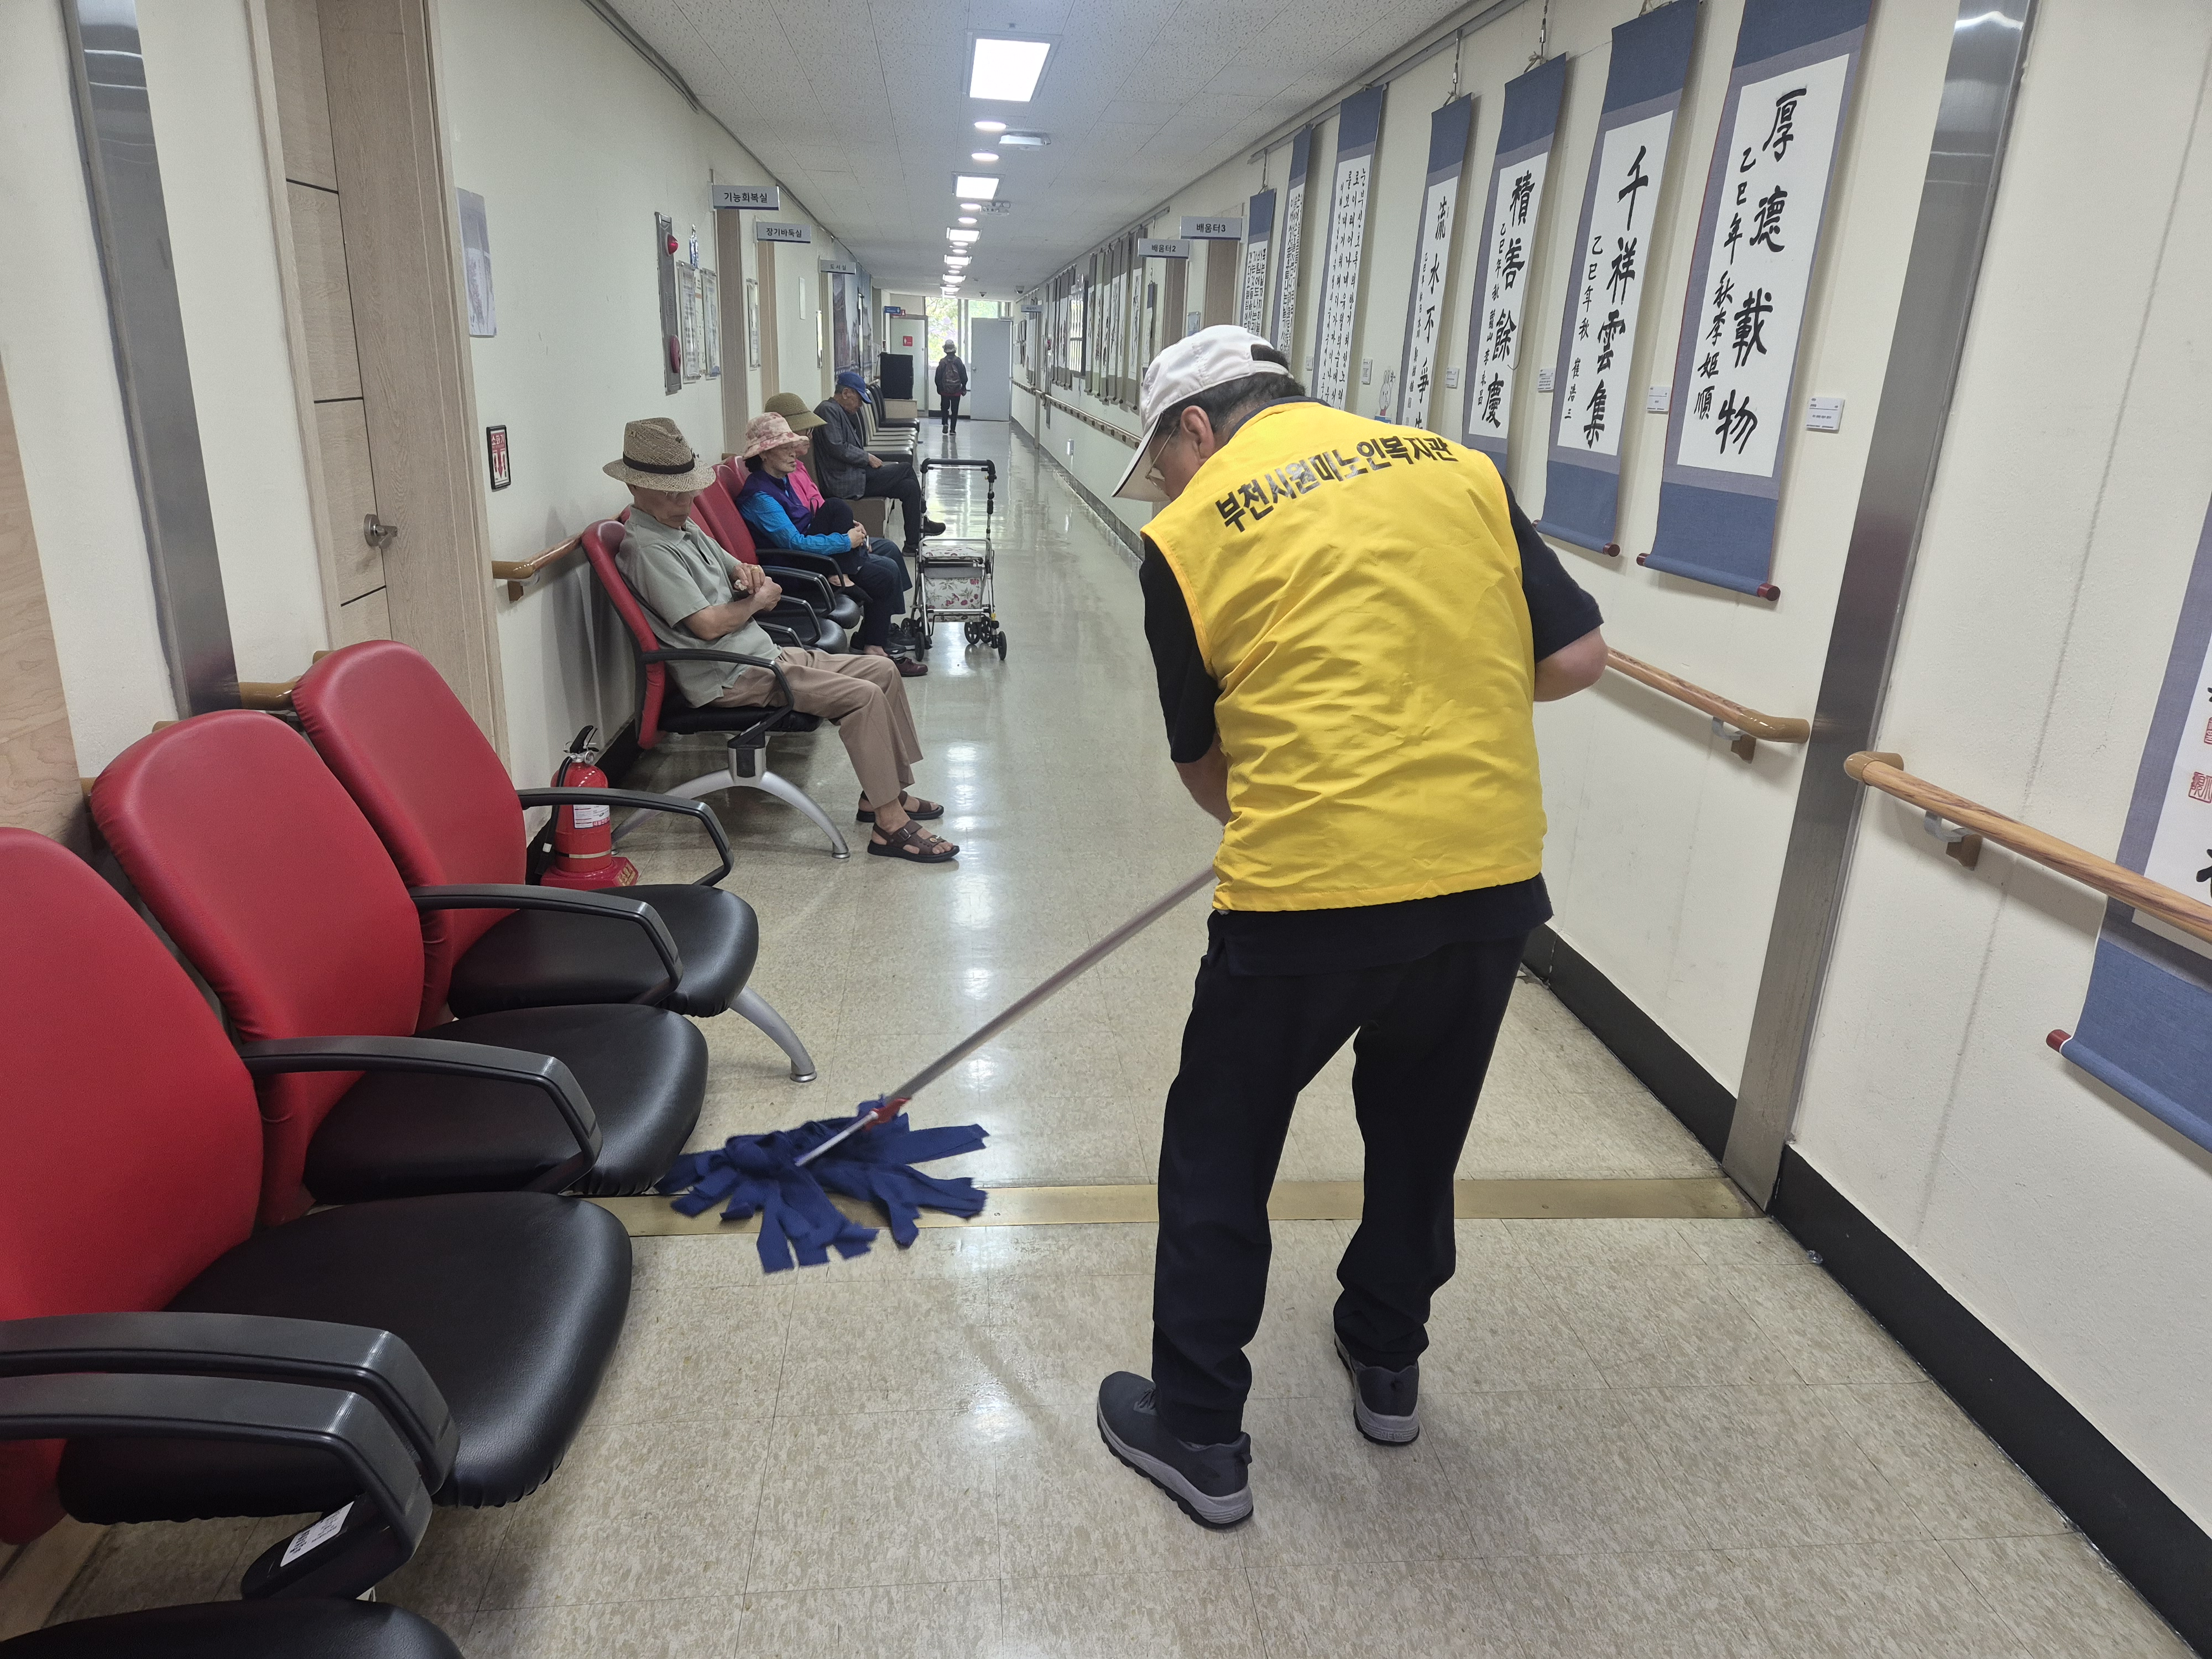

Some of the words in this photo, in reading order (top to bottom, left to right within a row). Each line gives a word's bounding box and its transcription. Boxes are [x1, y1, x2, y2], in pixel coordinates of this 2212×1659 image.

[724, 192, 768, 203] 기능회복실
[766, 228, 802, 238] 장기바둑실
[1196, 223, 1226, 233] 배움터3
[1151, 244, 1176, 253] 배움터2
[1583, 145, 1648, 449] 千祥雲集
[491, 434, 504, 446] 소화기
[1215, 435, 1459, 533] 부천시원미노인복지관
